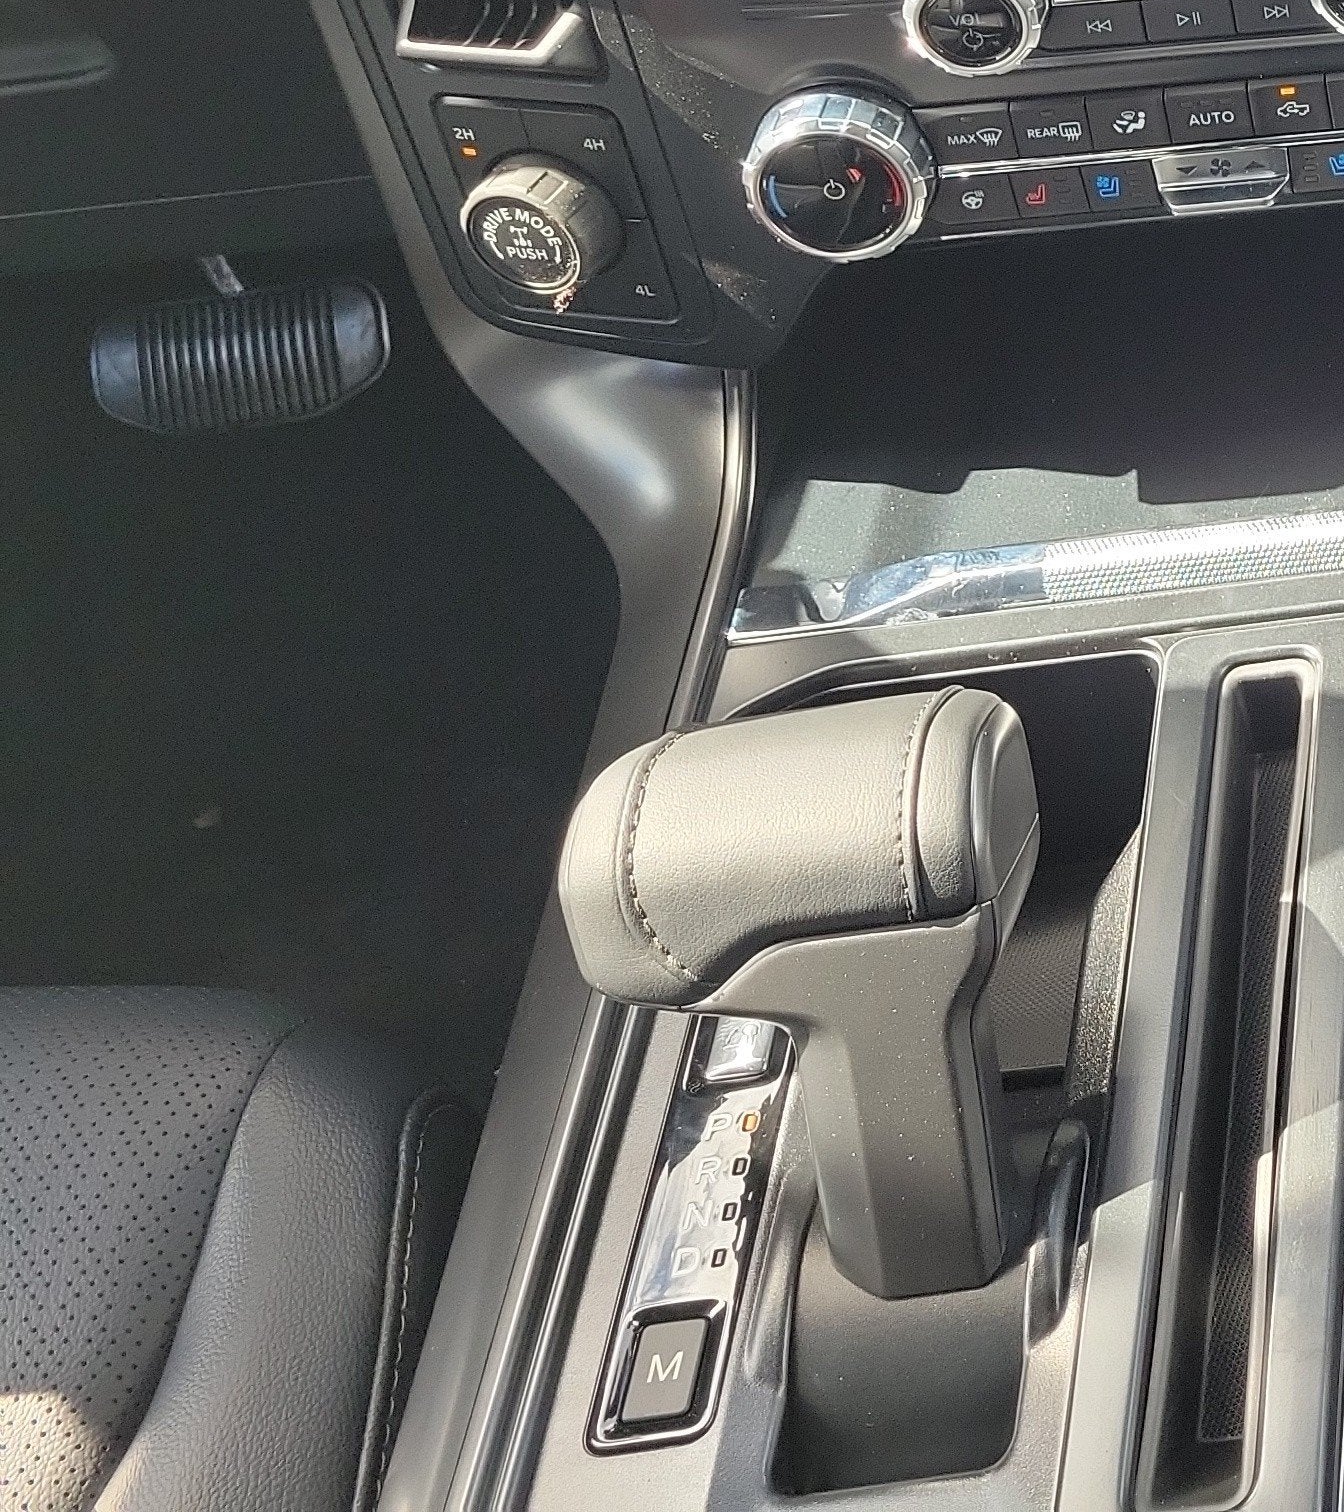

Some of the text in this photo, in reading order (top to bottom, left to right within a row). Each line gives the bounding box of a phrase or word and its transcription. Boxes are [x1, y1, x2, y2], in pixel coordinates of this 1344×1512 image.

[1189, 110, 1235, 127] AUTO
[452, 126, 476, 142] 2H
[947, 132, 978, 146] MAX
[1026, 125, 1058, 140] REAR
[583, 137, 606, 152] 4H
[482, 207, 563, 248] DRIVE MODE
[505, 245, 549, 262] PUSH
[635, 284, 656, 298] 4L
[704, 1112, 733, 1143] P
[695, 1156, 722, 1185] R
[681, 1200, 717, 1232] N
[670, 1245, 701, 1279] D
[646, 1350, 685, 1385] M
